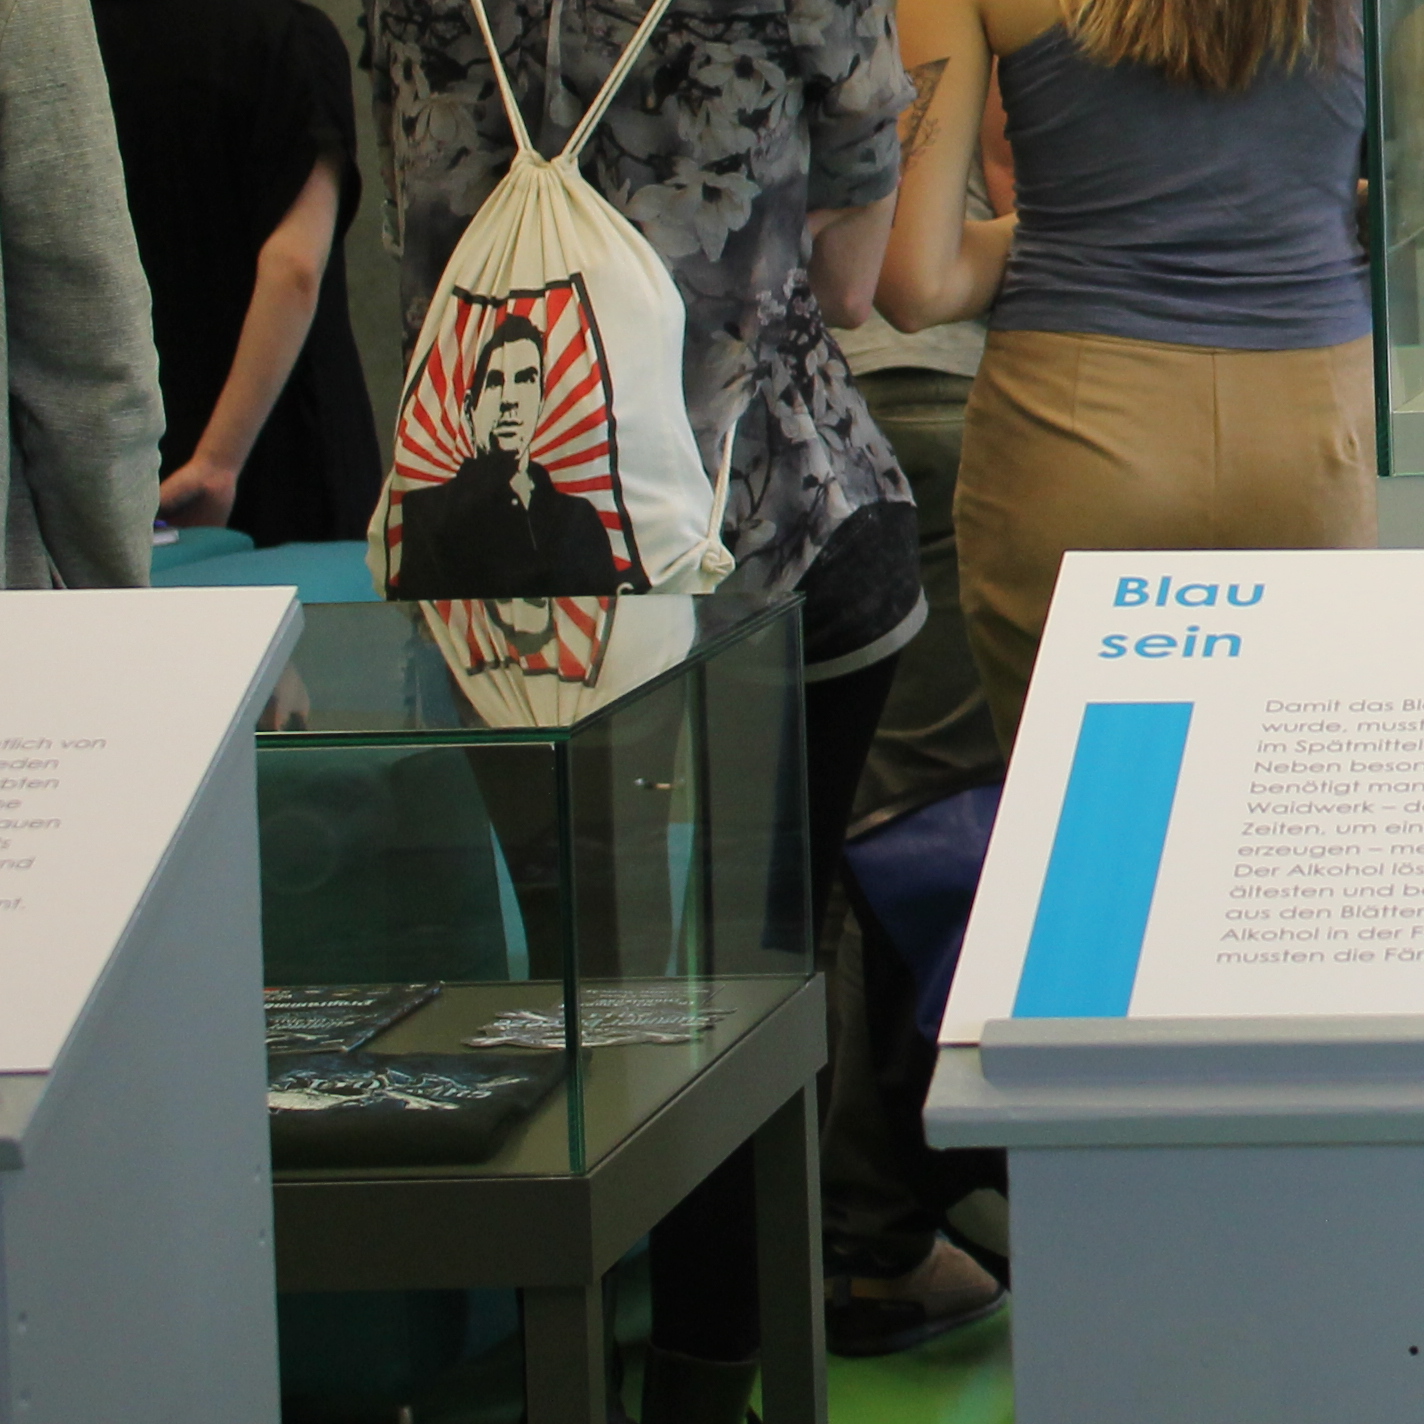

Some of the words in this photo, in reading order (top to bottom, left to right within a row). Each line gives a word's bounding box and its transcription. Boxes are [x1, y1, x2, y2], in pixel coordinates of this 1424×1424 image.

[1113, 576, 1264, 607] Blau
[1099, 625, 1241, 659] sein
[1265, 698, 1342, 714] Damit
[1348, 698, 1394, 713] das
[0, 737, 53, 751] tlich
[61, 738, 107, 750] von
[1256, 739, 1288, 754] im
[1253, 759, 1342, 774] Neben
[1249, 779, 1361, 797] benötigt
[1246, 799, 1375, 815] Waidwerk
[1335, 823, 1377, 835] um
[1237, 844, 1361, 860] erzeugen
[1233, 863, 1281, 878] Der
[1286, 862, 1385, 878] Alkohol
[1229, 884, 1335, 900] ältesten
[1342, 882, 1395, 898] und
[1224, 908, 1271, 921] aus
[1278, 904, 1332, 921] den
[1219, 926, 1320, 942] Alkohol
[1326, 925, 1350, 941] in
[1356, 925, 1403, 941] der
[1216, 948, 1325, 964] mussten
[1333, 947, 1376, 963] die
